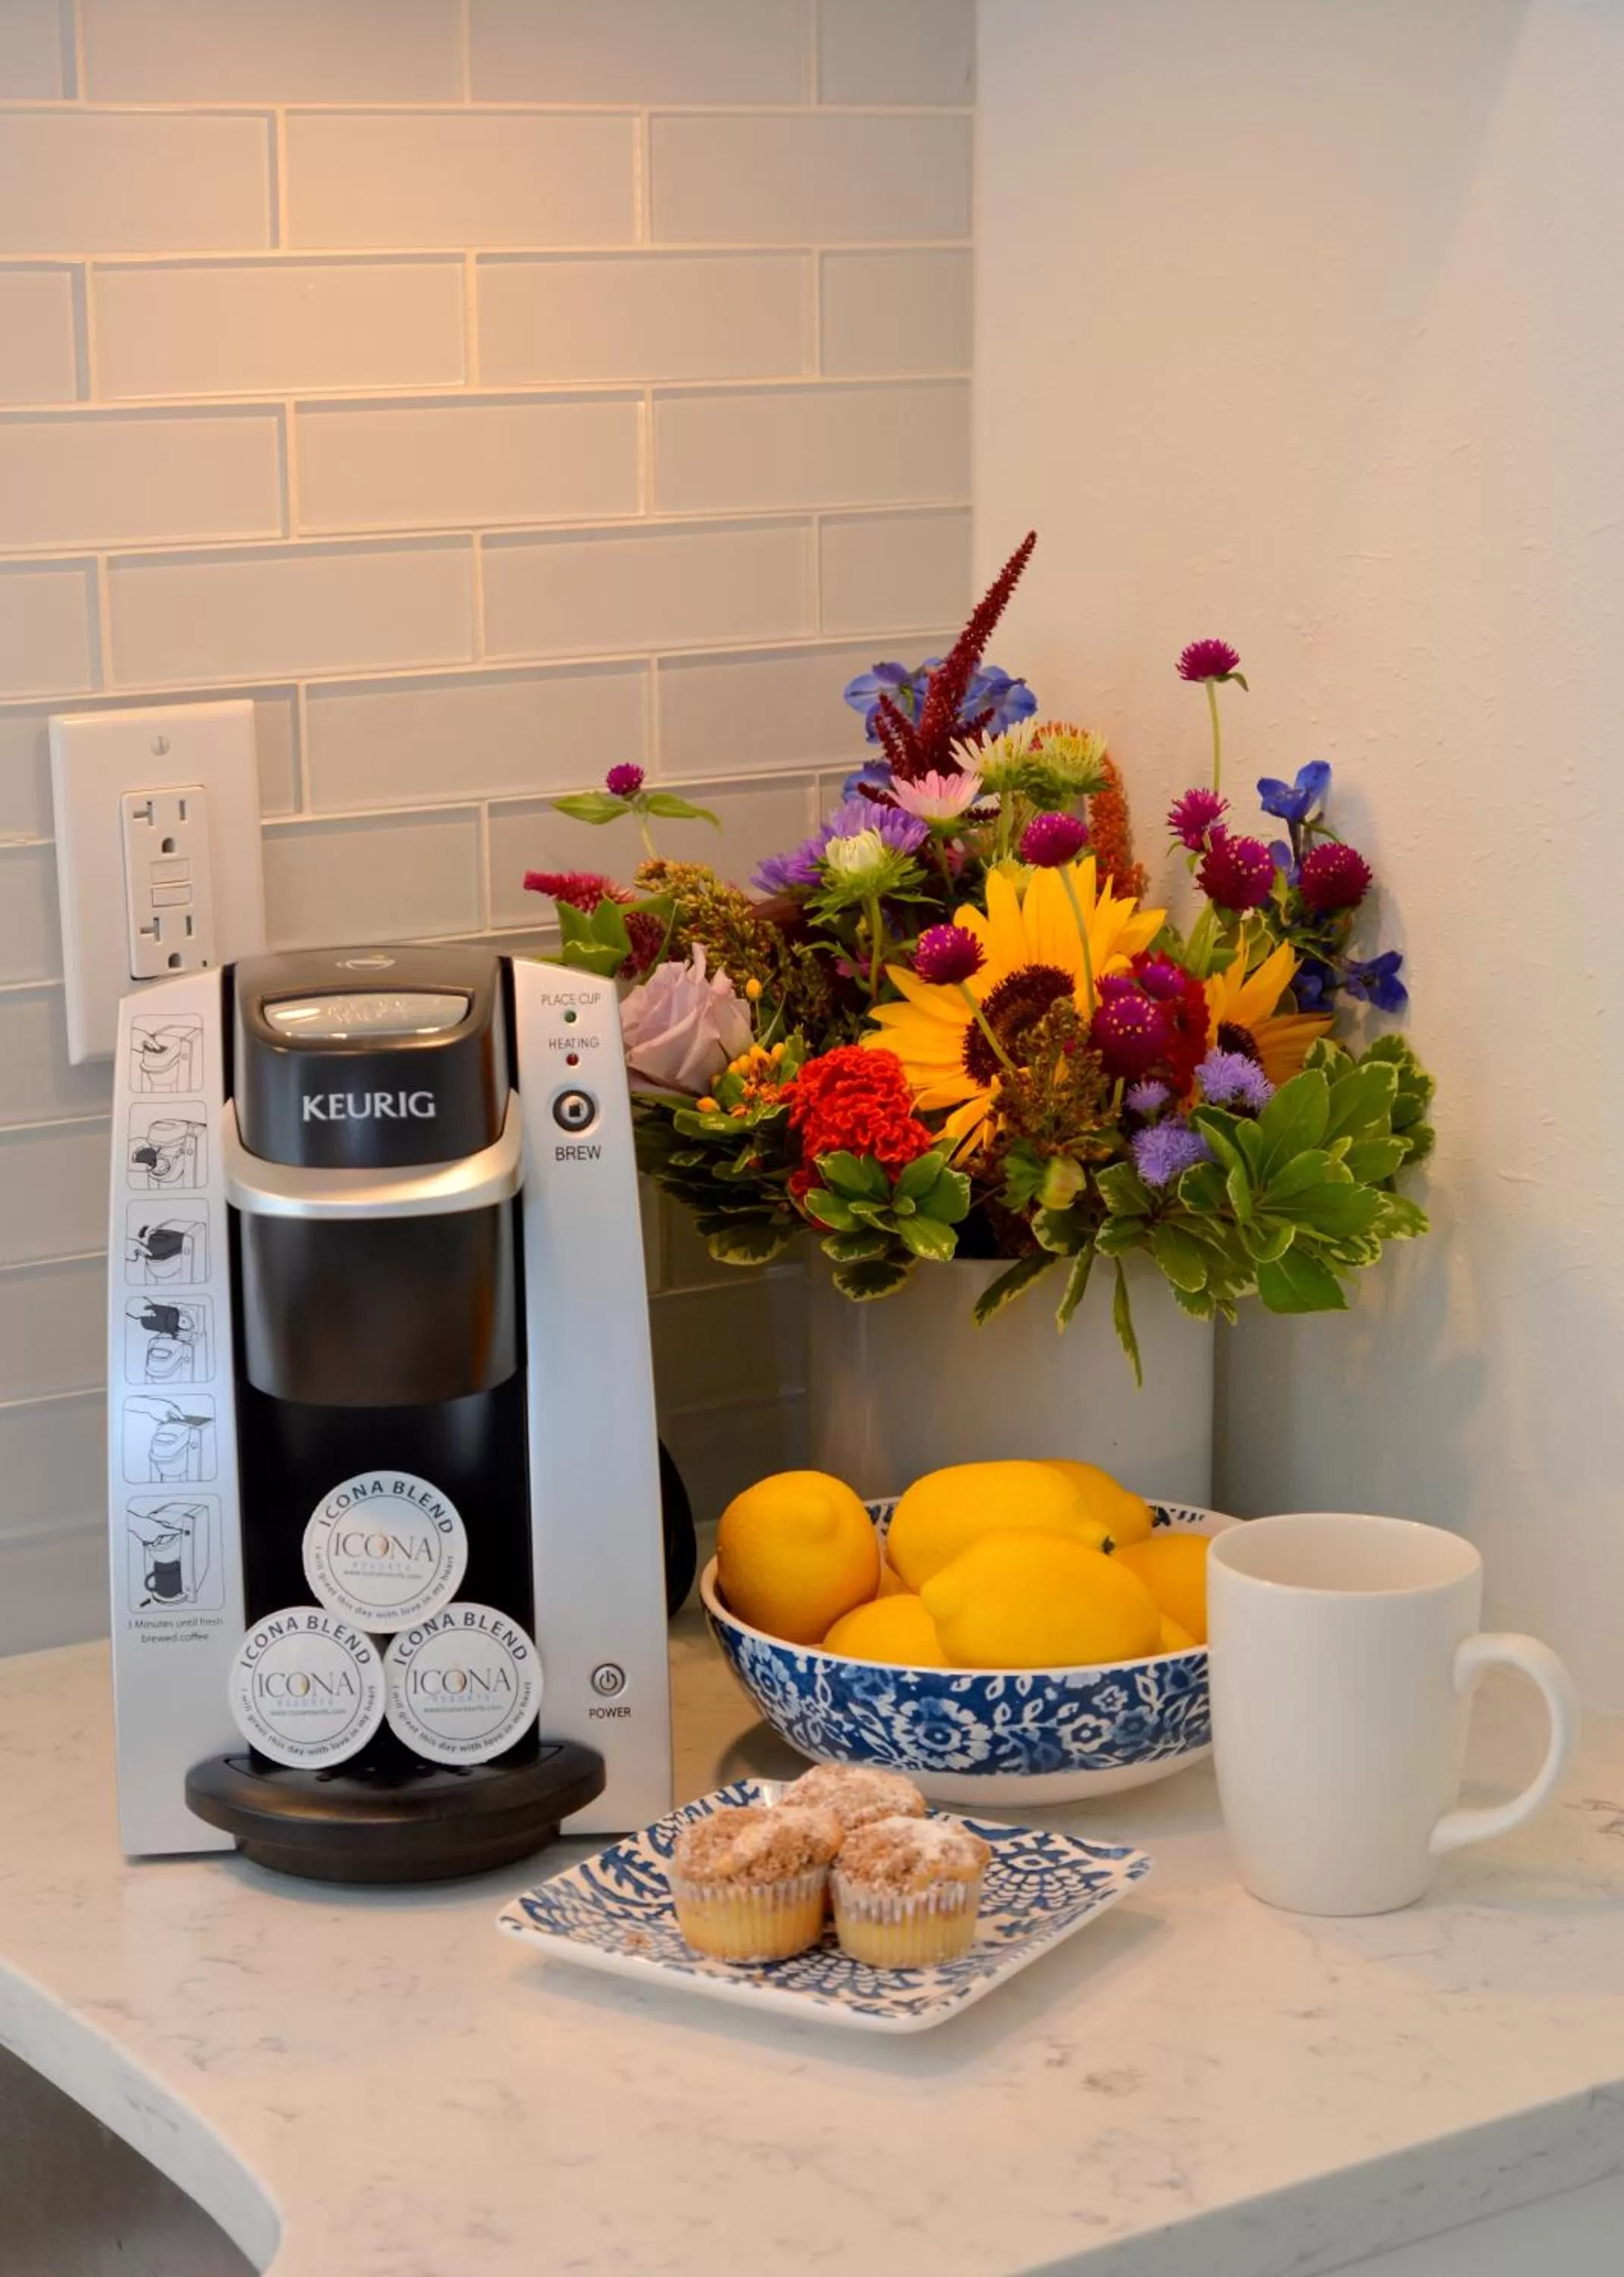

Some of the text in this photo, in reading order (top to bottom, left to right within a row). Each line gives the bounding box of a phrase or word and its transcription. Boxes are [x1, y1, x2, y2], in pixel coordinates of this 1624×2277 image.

[541, 992, 602, 1006] PLACE CUP
[549, 1037, 600, 1049] HEATING
[302, 1091, 436, 1122] KEURIG
[554, 1145, 602, 1161] BREW
[319, 1480, 453, 1534] ICONA BLEND
[334, 1532, 434, 1563] ICONA
[134, 1619, 174, 1628] Minutes
[175, 1617, 198, 1627] until
[200, 1617, 224, 1626] fresh
[140, 1633, 209, 1643] brewed coffee
[240, 1615, 371, 1668] ICONA BLEND
[392, 1611, 527, 1665] ICONA BLEND
[257, 1671, 355, 1698] ICONA
[412, 1667, 511, 1693] ICONA
[438, 1741, 455, 1752] day
[520, 1682, 530, 1708] heart
[588, 1707, 631, 1719] POWER
[287, 1745, 303, 1754] day
[356, 1714, 369, 1728] my
